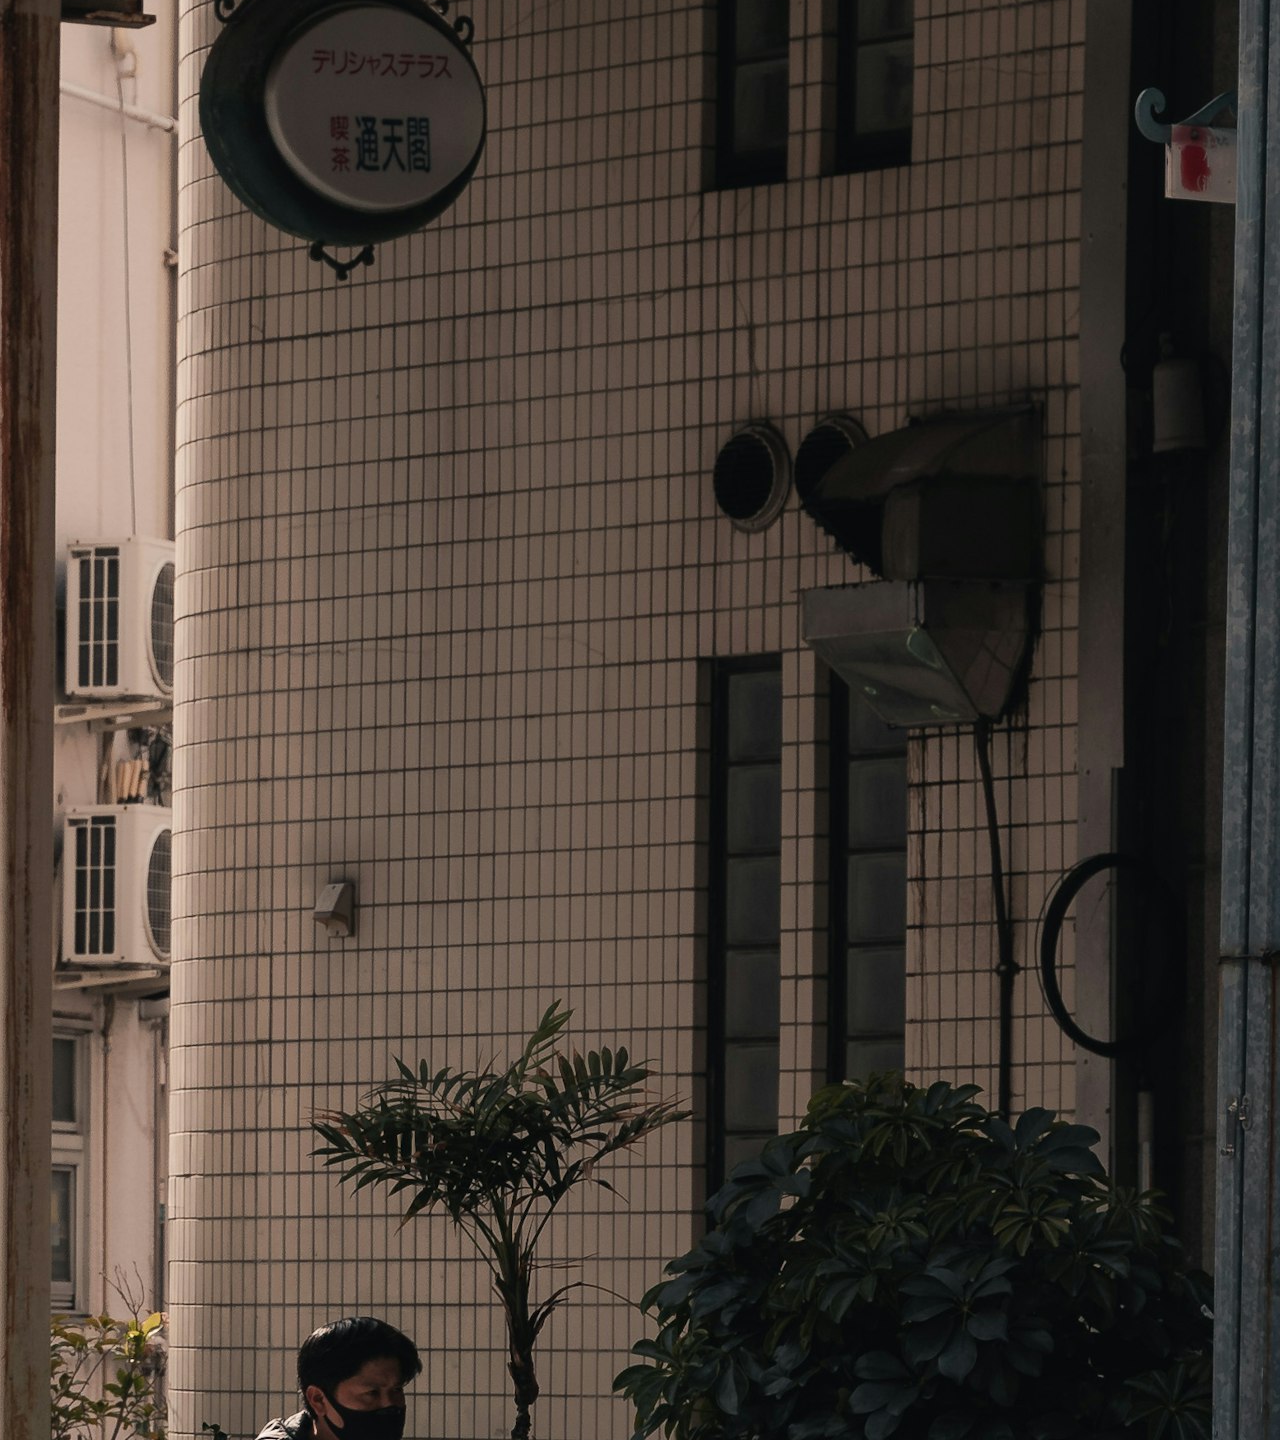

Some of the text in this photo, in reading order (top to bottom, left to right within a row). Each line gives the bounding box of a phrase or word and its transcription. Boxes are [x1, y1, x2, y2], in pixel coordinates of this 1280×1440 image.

[311, 49, 453, 80] デリシャステラス
[330, 115, 351, 173] 喫茶
[354, 115, 432, 173] 通天閣
